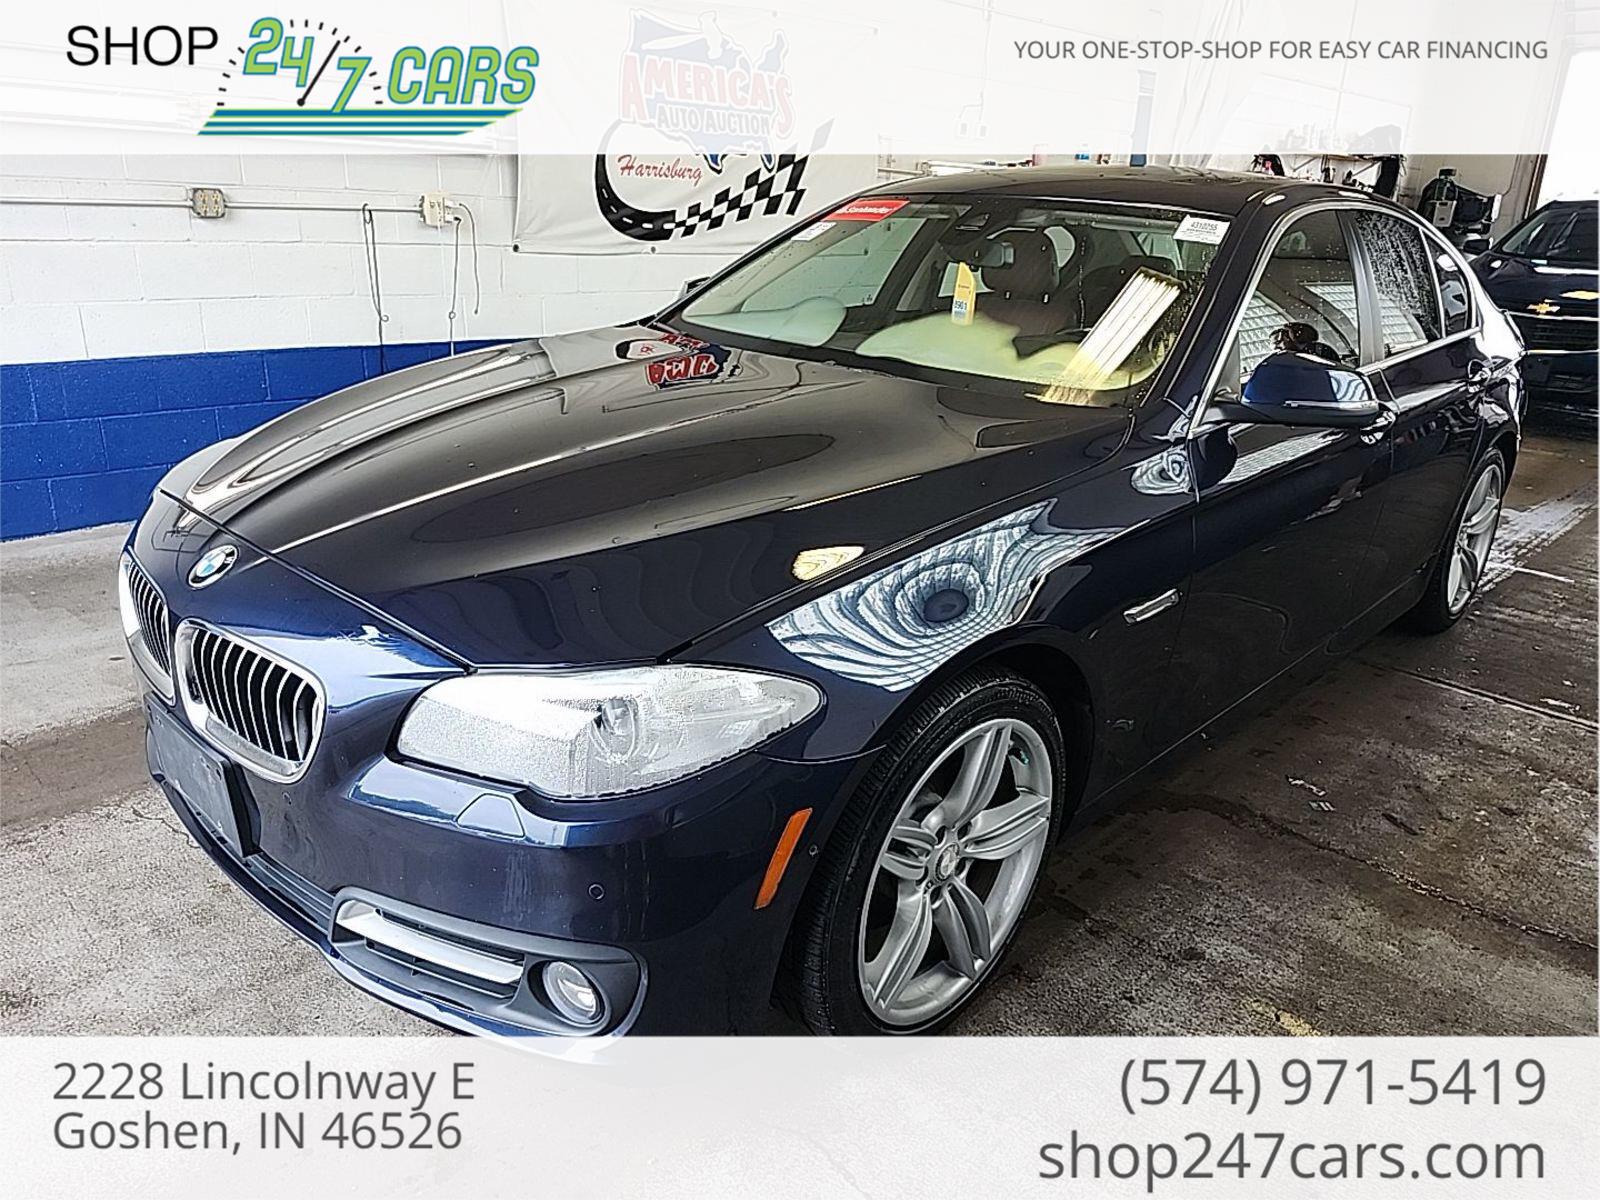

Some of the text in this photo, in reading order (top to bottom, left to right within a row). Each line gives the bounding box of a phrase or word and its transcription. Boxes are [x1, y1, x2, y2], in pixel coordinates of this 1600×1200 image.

[621, 52, 793, 137] AMERICA'S
[656, 104, 771, 137] AUTO AUCTION
[617, 153, 703, 187] Harrisburg
